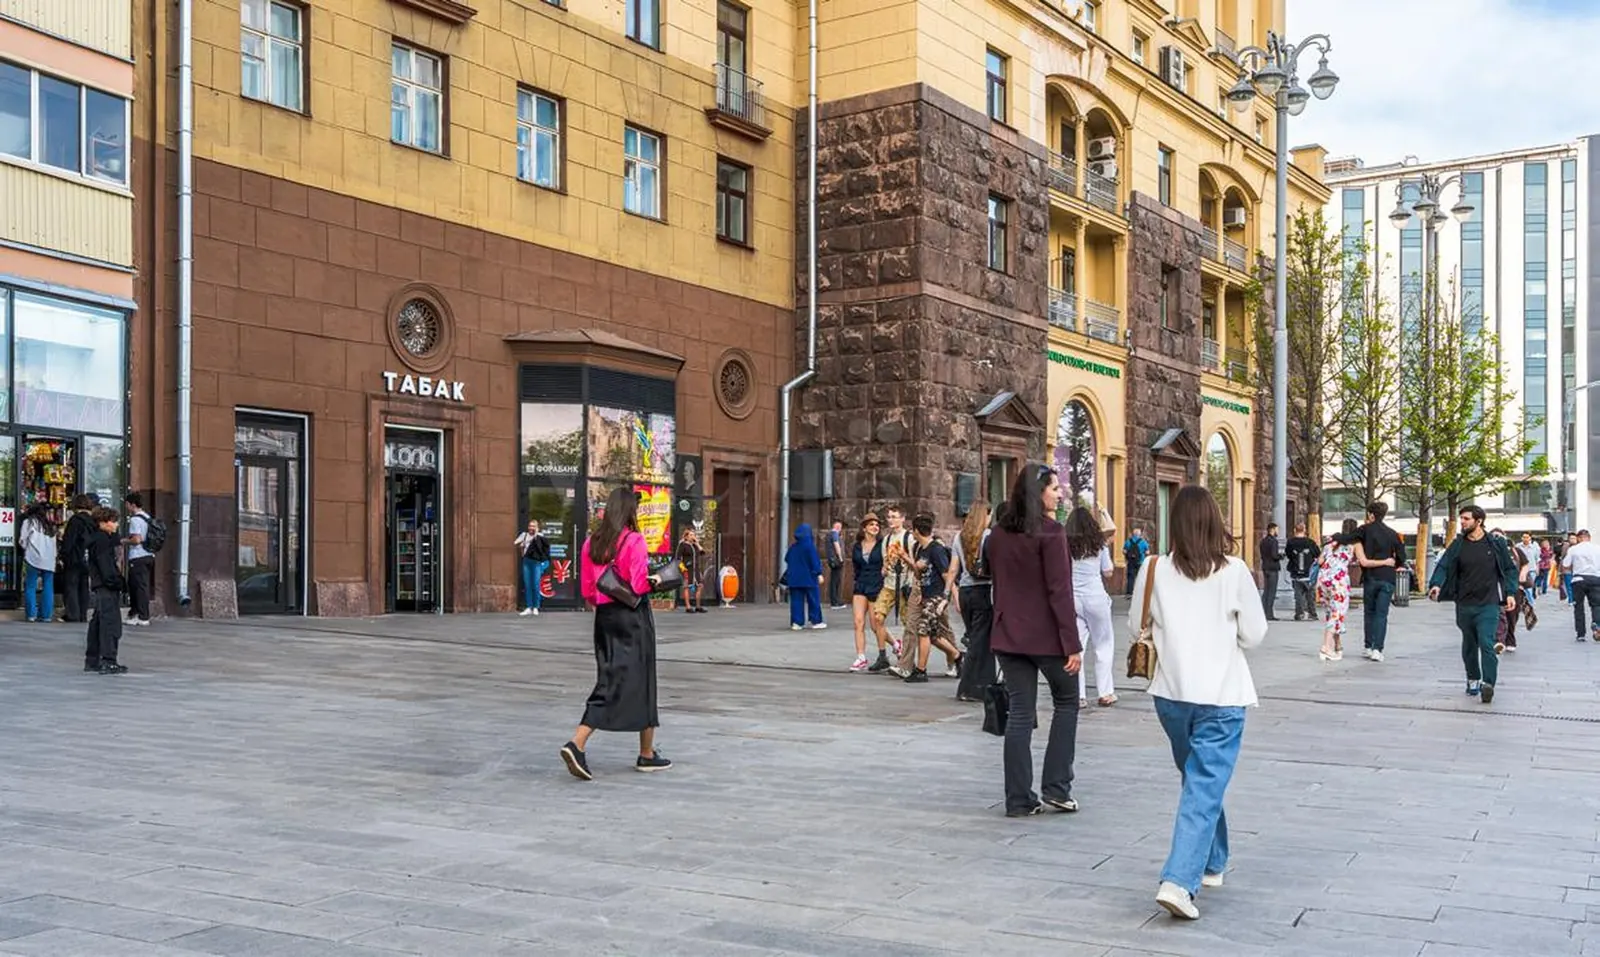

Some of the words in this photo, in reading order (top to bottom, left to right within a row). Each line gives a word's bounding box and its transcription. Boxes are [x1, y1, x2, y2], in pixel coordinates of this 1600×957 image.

[383, 371, 466, 401] ТАБАК
[536, 464, 579, 474] ФОРАБАНК
[2, 511, 13, 523] 24
[553, 559, 571, 583] ¥
